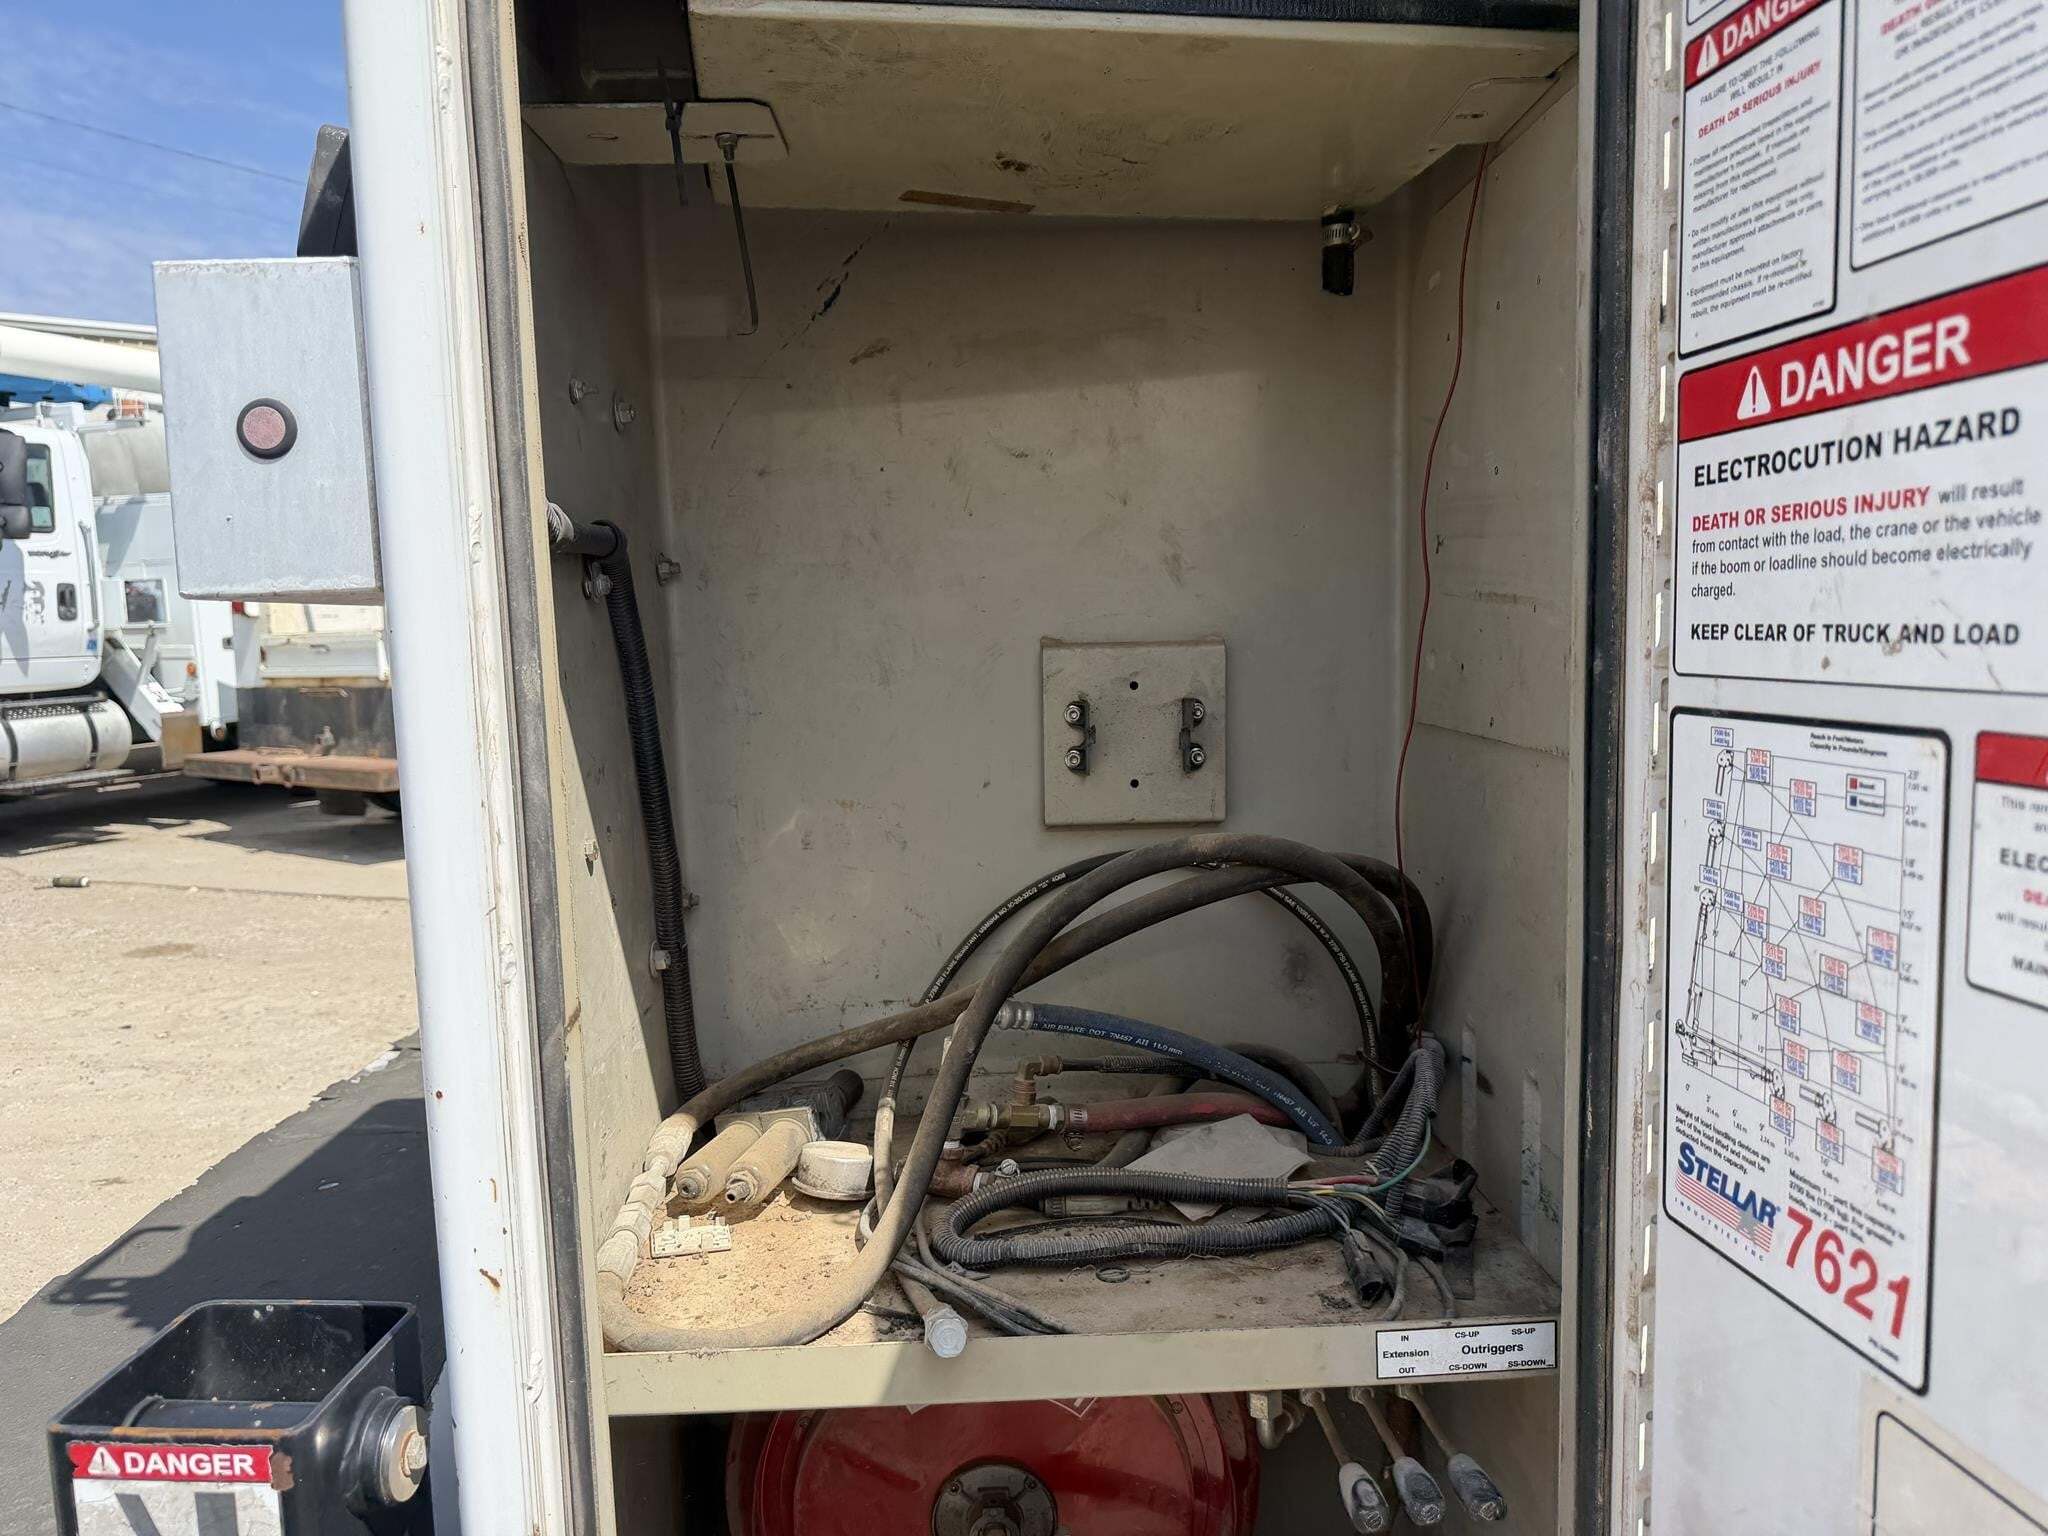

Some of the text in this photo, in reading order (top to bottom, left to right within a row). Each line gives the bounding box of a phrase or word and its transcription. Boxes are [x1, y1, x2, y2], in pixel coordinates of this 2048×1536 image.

[1780, 314, 1971, 407] DANGER
[1694, 407, 2020, 487] ELECTROCUTION HAZARD
[1692, 479, 2024, 532] DEATH OR SERIOUS INJURY will result
[1692, 506, 2042, 554] from contact with the load, the crane or the vehicle
[1692, 537, 2033, 575] if the boom or loadline should become electrically
[1691, 582, 1736, 600] charged.
[1691, 623, 2020, 645] KEEP CLEAR OF TRUCK AND LOAD
[1786, 1205, 1910, 1339] 7621
[1454, 1331, 1479, 1339] CS-UP
[1511, 1327, 1536, 1335] SS-UP
[1382, 1349, 1429, 1359] Extension
[1461, 1343, 1524, 1355] Outriggers
[1449, 1363, 1487, 1371] CS-DOWN
[1508, 1359, 1546, 1368] SS-DOWN
[123, 1451, 256, 1476] DANGER
